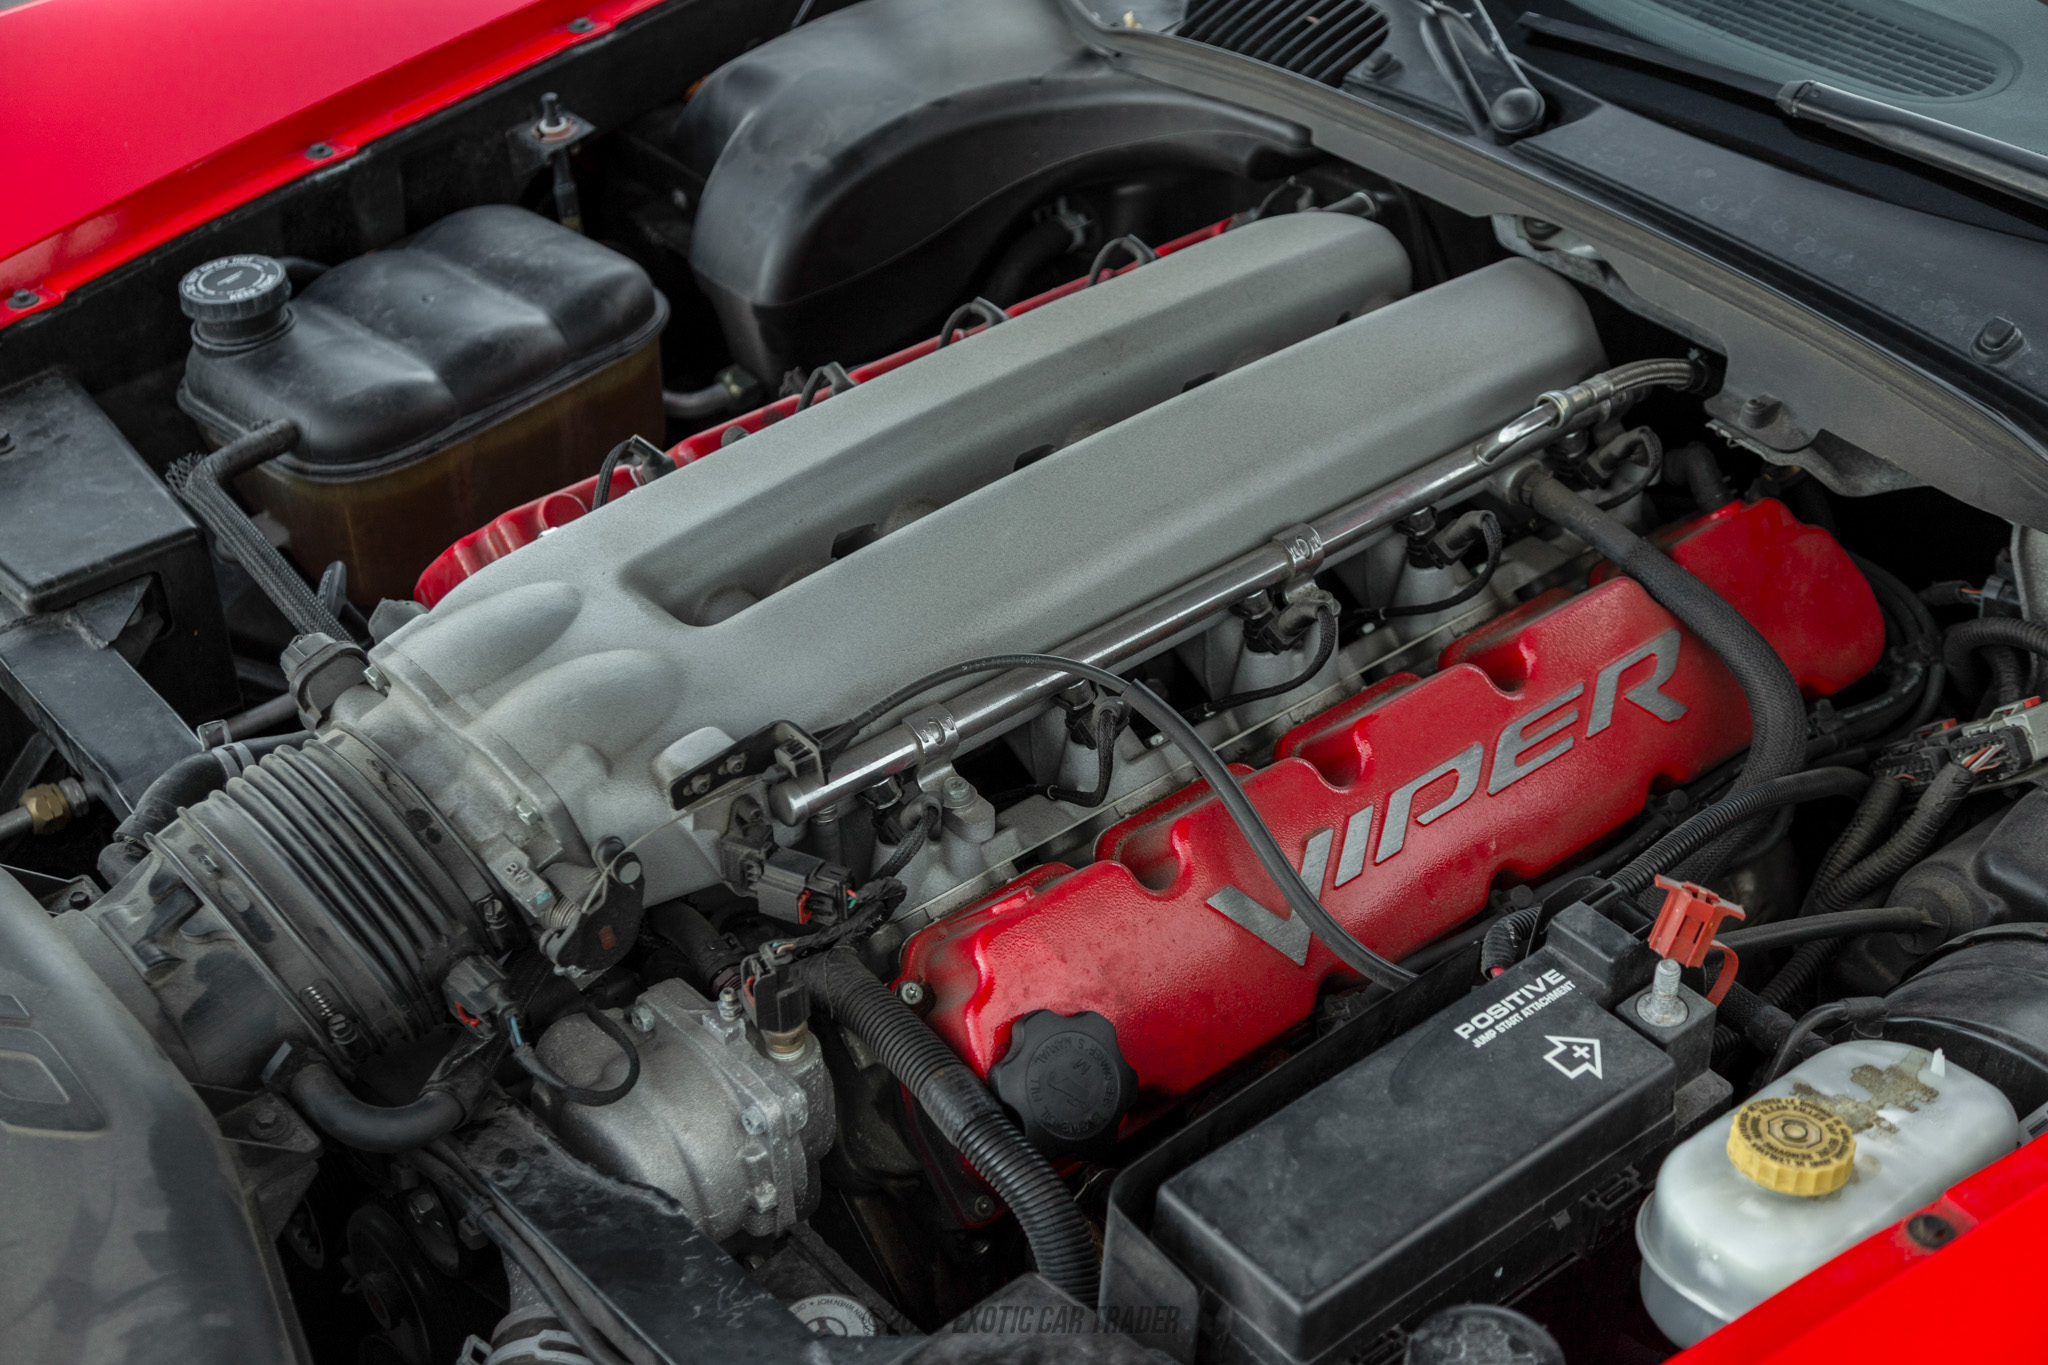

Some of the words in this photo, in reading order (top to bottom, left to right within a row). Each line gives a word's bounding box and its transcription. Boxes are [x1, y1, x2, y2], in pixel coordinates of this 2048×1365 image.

[1205, 629, 1687, 966] VIPER
[503, 862, 531, 884] BW
[1454, 968, 1566, 1039] POSITIVE
[1471, 1028, 1497, 1048] JUMP
[1494, 1012, 1523, 1033] START
[1520, 979, 1576, 1017] ATTACHMENT
[1033, 1036, 1072, 1064] MANUAL
[816, 1298, 833, 1306] HOT
[833, 1298, 855, 1313] WHEN
